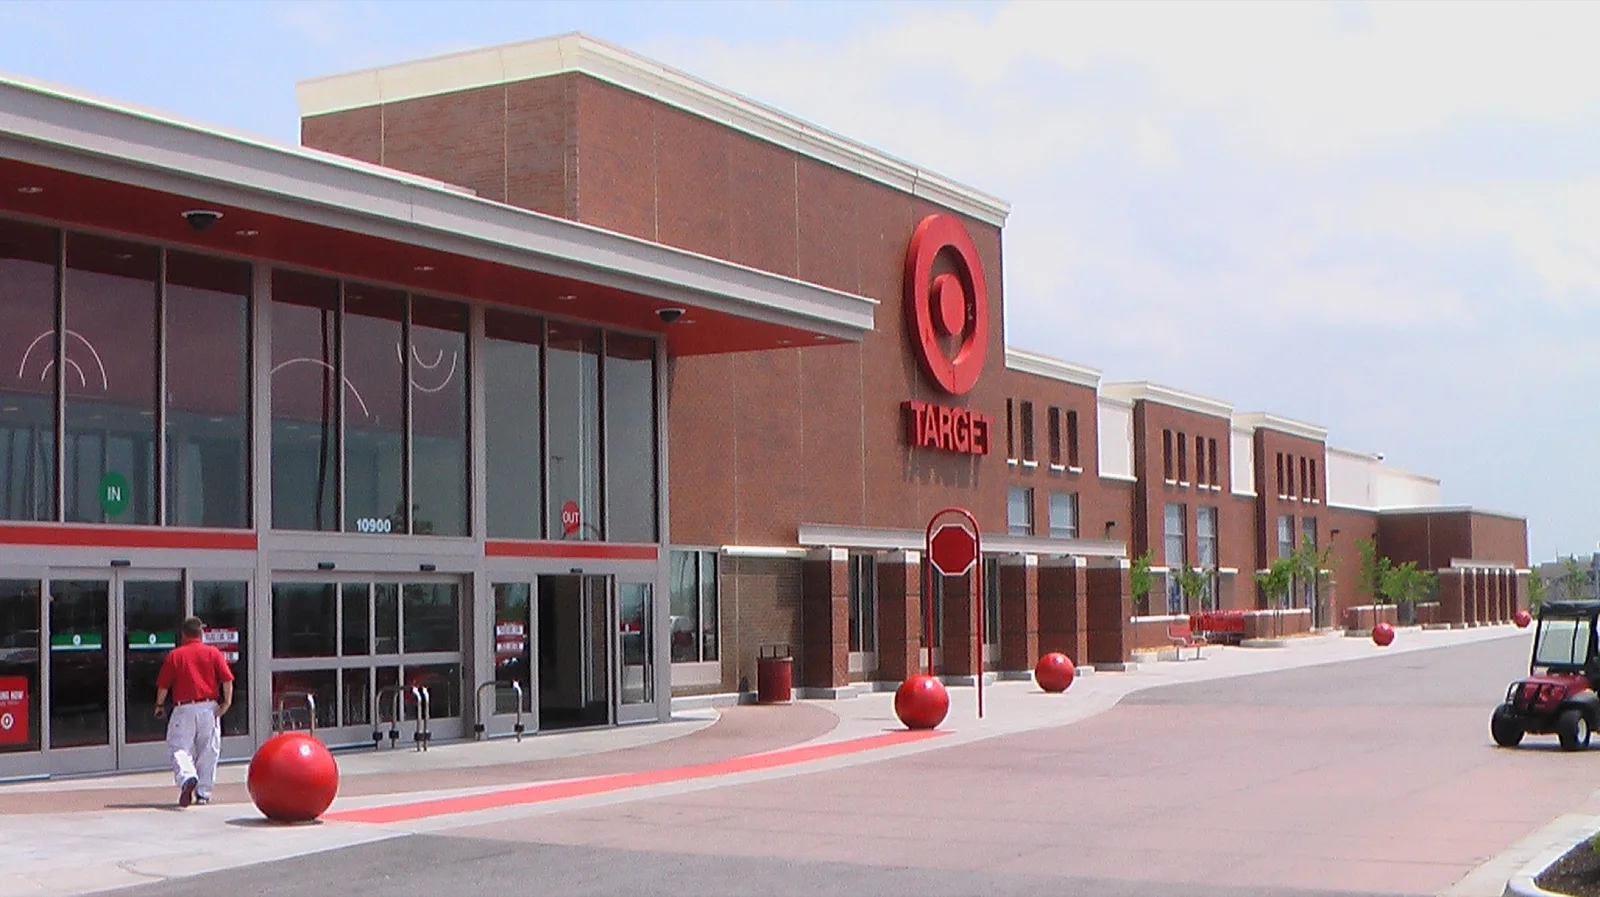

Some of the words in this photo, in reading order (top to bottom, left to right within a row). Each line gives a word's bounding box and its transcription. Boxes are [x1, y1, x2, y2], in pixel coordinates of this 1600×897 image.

[905, 399, 996, 456] TARGET
[107, 485, 121, 502] IN
[356, 517, 392, 533] 10900
[562, 511, 579, 524] OUT
